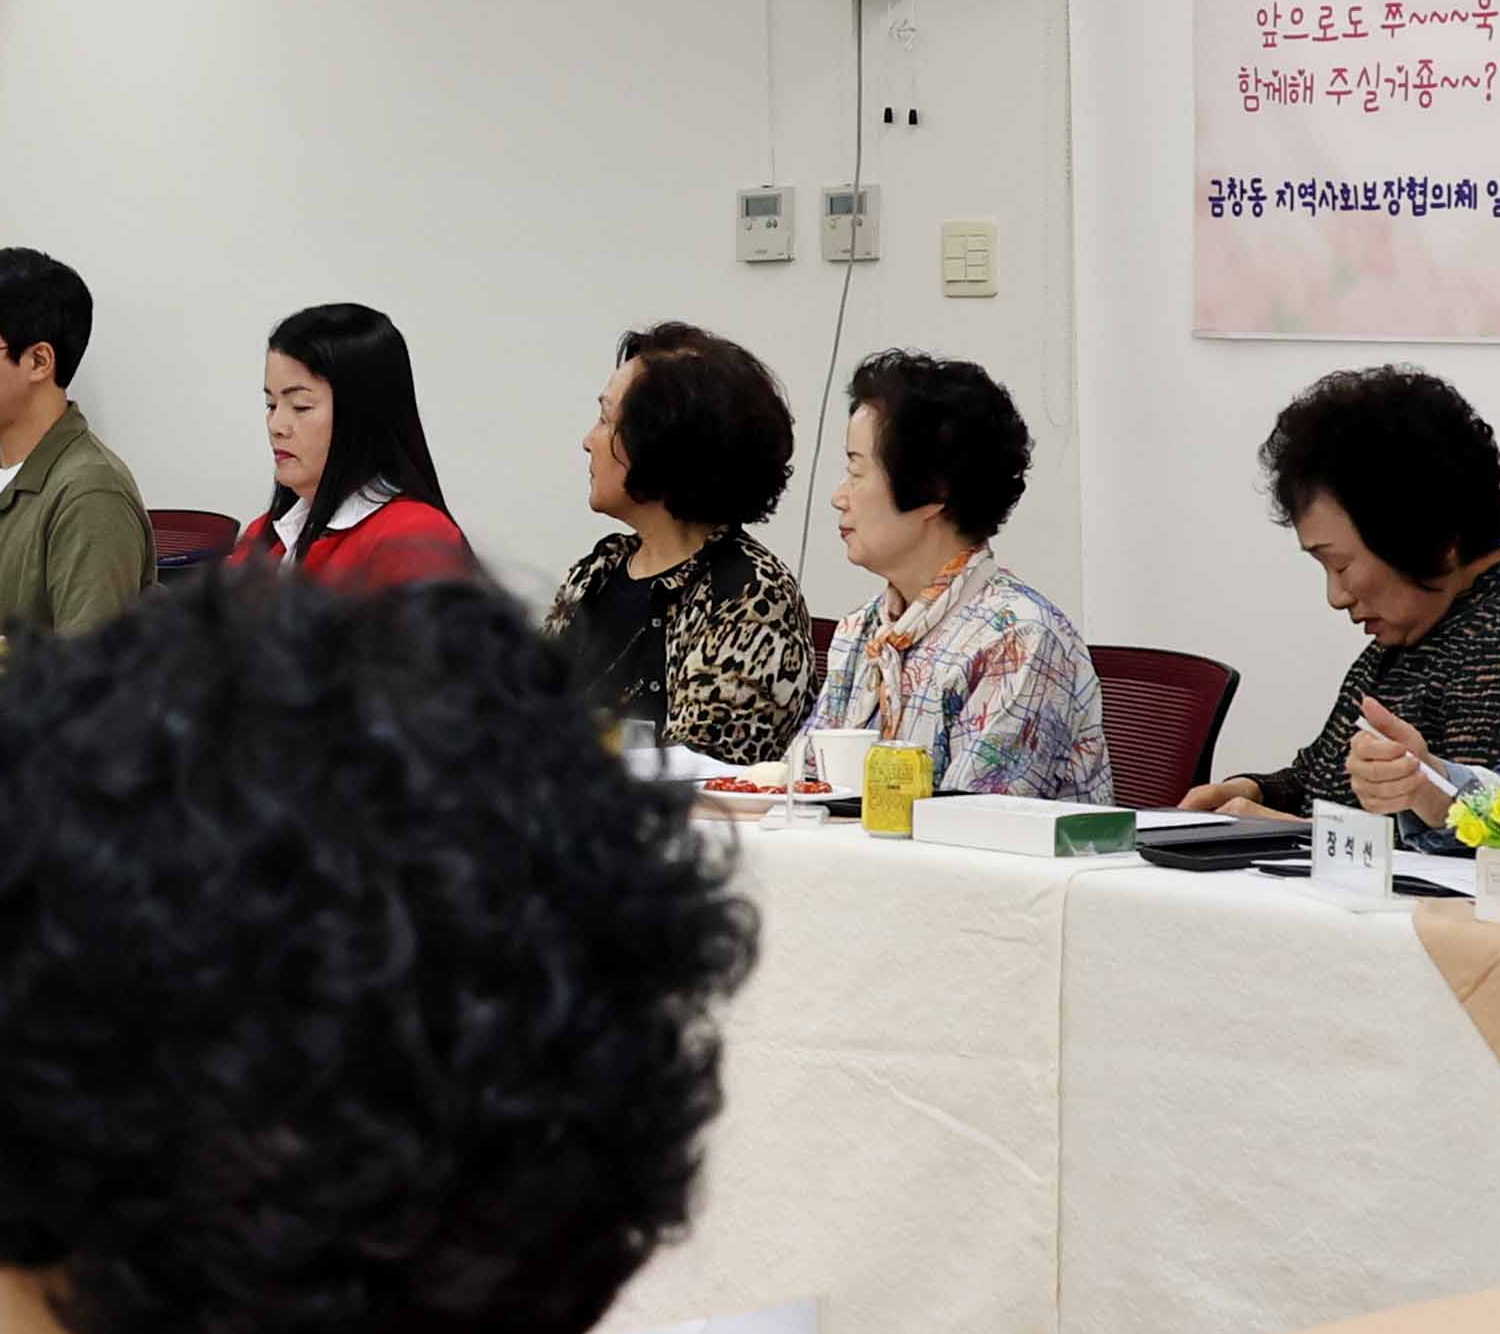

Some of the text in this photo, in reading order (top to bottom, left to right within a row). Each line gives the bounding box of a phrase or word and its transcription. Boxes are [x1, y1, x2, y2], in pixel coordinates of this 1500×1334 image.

[1256, 2, 1369, 48] 앞으로도
[1238, 67, 1314, 112] 함께해
[1208, 177, 1267, 218] 금창동
[1275, 175, 1478, 218] 지역사회보장협의체
